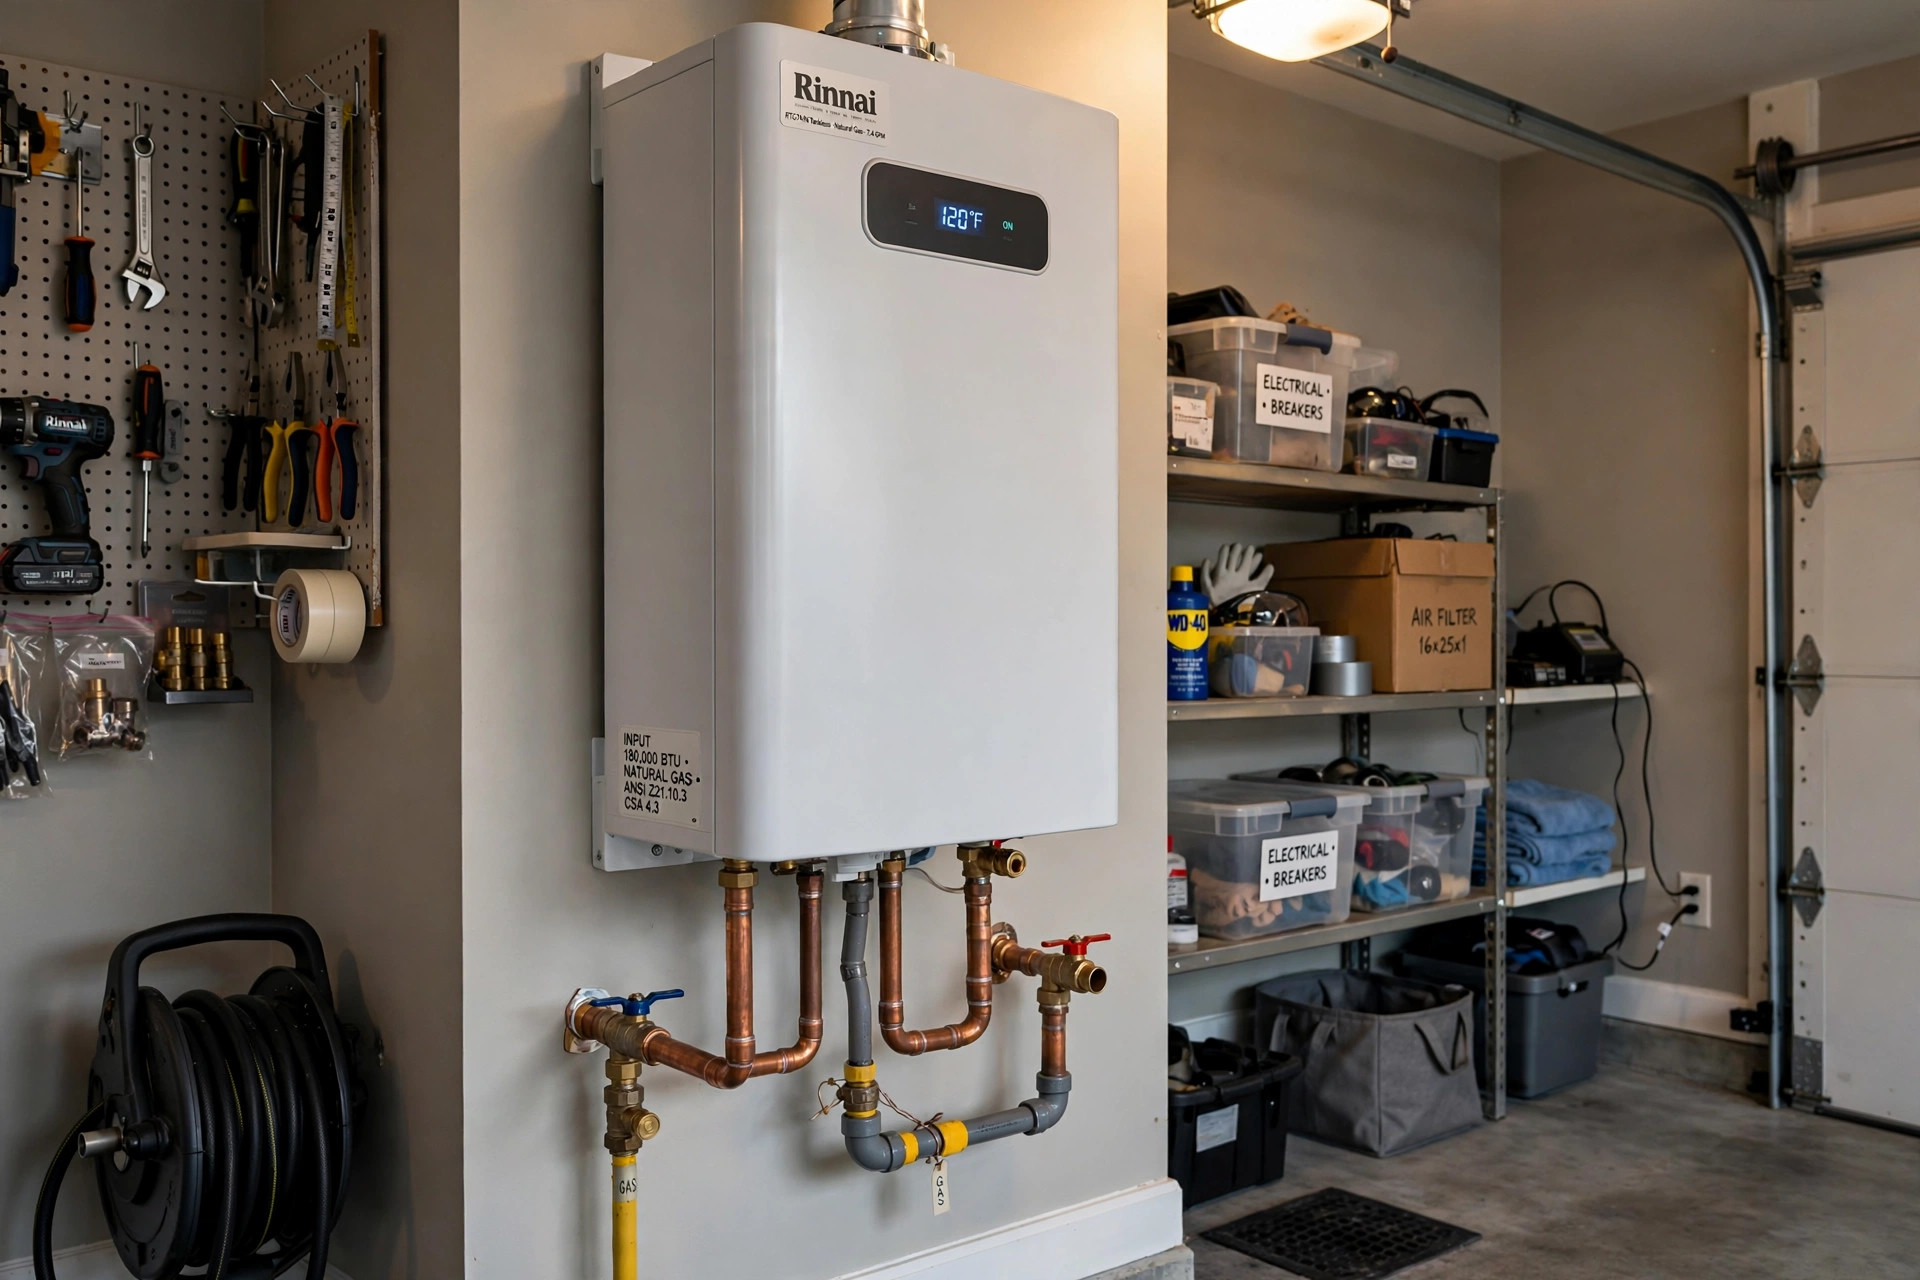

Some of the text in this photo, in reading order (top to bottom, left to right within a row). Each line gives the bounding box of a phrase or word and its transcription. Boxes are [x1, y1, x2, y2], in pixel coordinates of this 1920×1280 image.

[794, 71, 877, 116] Rinnai
[1002, 220, 1014, 231] ON
[1264, 374, 1324, 397] ELECTRICAL
[1271, 398, 1323, 421] BREAKERS
[1411, 606, 1478, 627] AIR FILTER
[1419, 634, 1467, 655] 16x25x1
[623, 732, 651, 748] INPUT
[660, 752, 681, 768] BTU
[623, 764, 693, 787] NATURAL GAS
[623, 780, 687, 803] ANSI Z21.10.3
[624, 796, 660, 815] CSA 4.3
[1268, 842, 1329, 865] ELECTRICAL
[1273, 865, 1327, 888] BREAKERS
[619, 1177, 637, 1195] GAS
